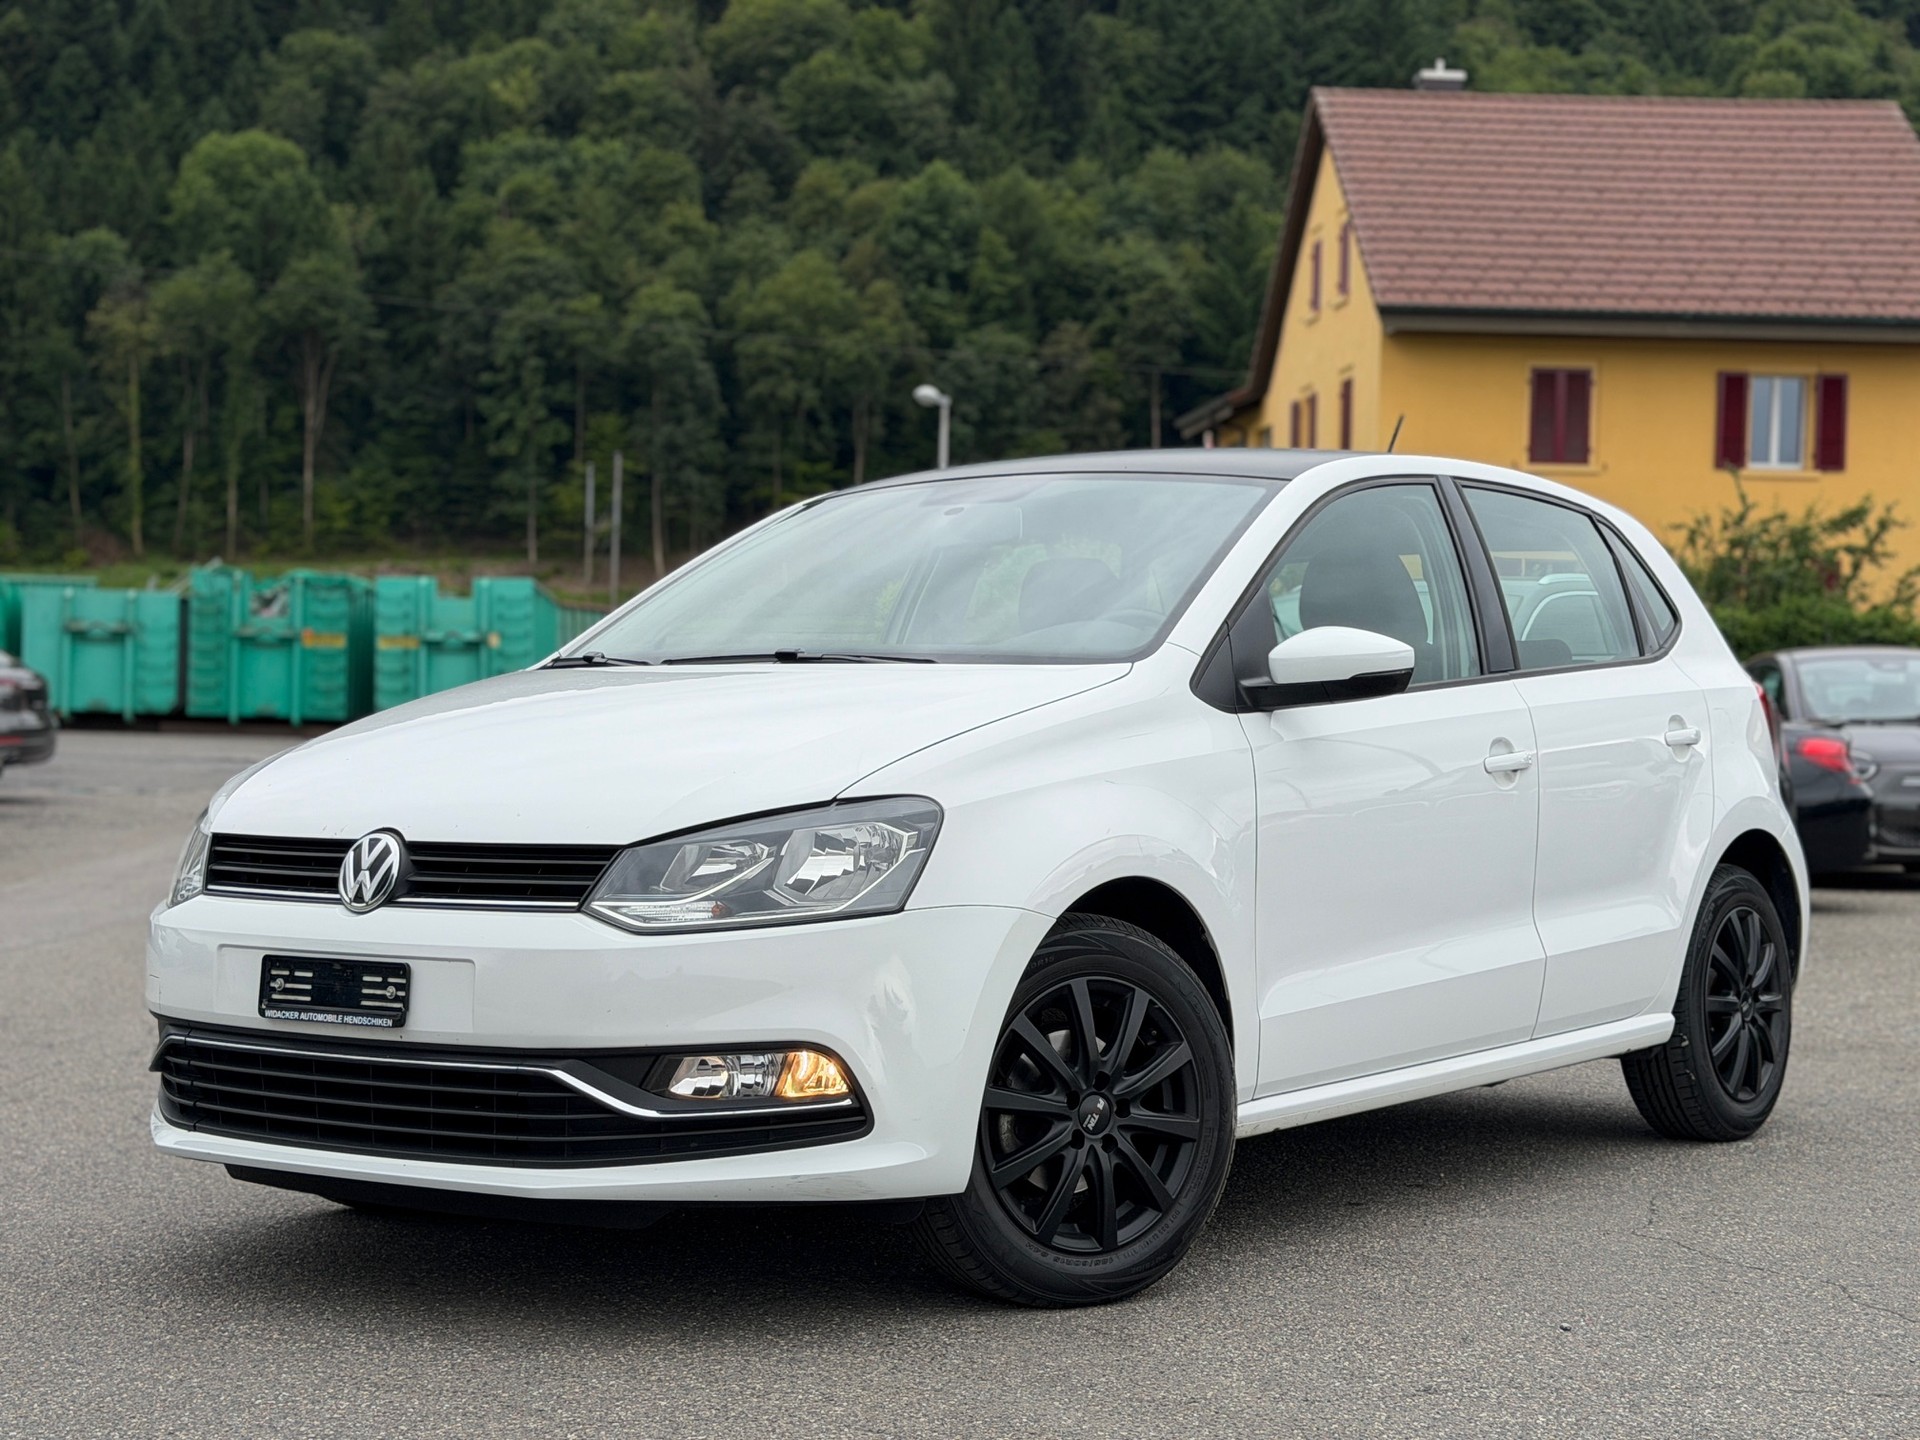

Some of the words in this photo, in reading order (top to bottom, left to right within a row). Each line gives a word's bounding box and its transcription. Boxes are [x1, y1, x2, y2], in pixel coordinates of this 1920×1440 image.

[343, 833, 397, 907] VW
[265, 1009, 299, 1019] WIDACKER
[300, 1012, 342, 1023] AUTOMOBILE
[343, 1016, 393, 1027] HENDSCHIKEN
